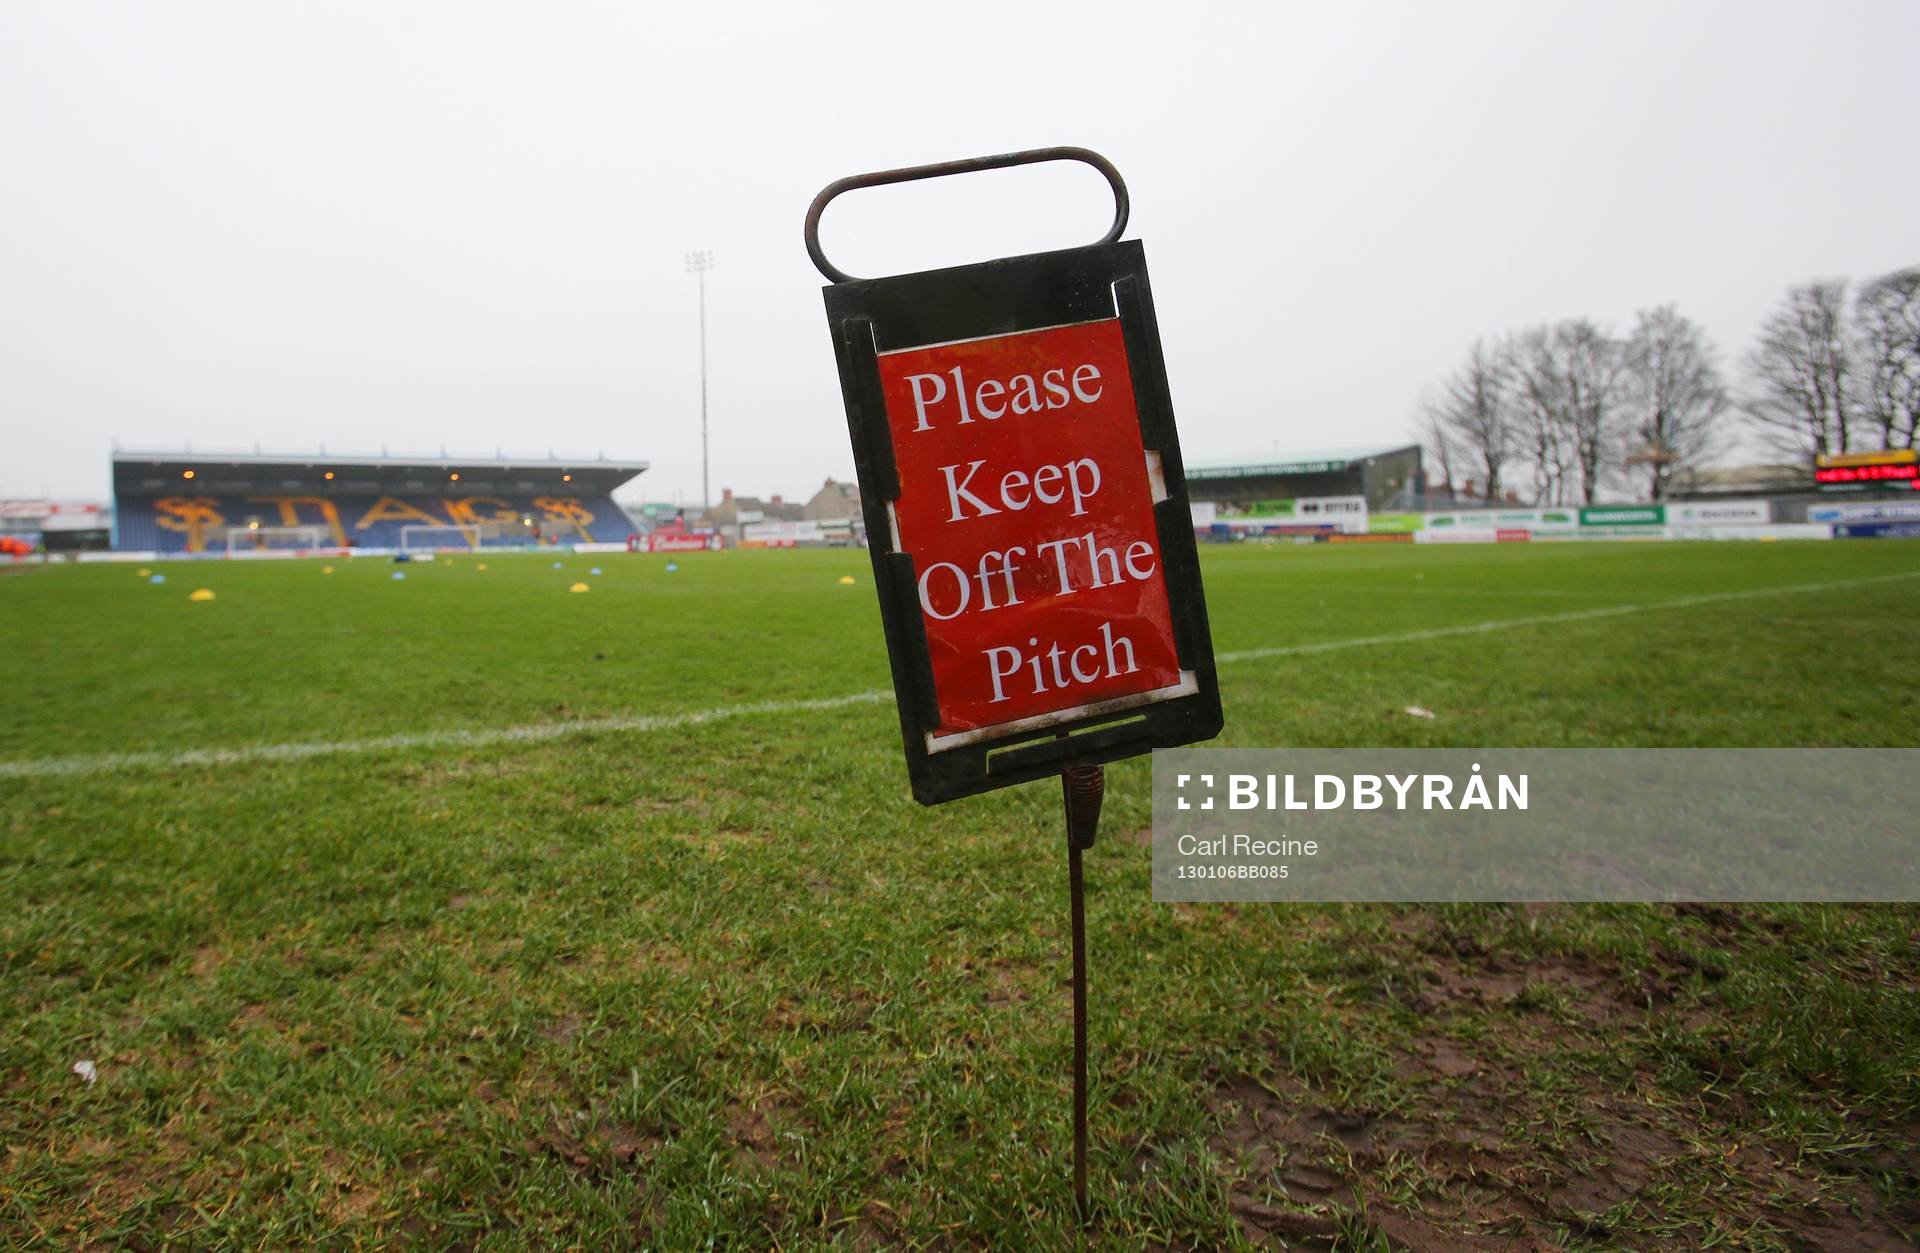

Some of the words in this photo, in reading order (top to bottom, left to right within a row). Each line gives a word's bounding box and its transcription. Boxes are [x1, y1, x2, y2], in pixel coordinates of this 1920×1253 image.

[904, 364, 1103, 431] Please
[938, 456, 1102, 523] Keep
[917, 546, 1026, 620] Off
[1037, 532, 1156, 596] The
[982, 623, 1140, 702] Pitch
